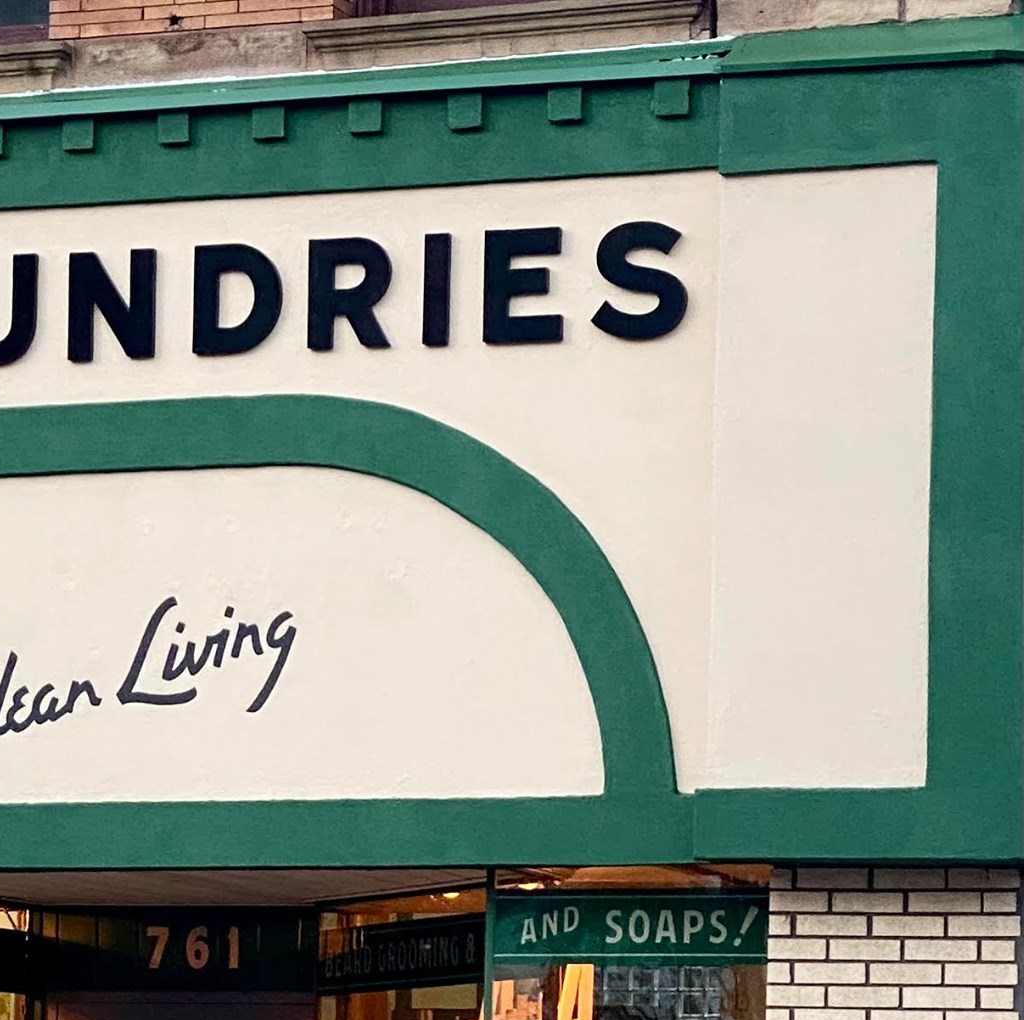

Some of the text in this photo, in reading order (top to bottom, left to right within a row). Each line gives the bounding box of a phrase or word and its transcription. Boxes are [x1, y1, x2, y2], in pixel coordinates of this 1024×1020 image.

[117, 596, 297, 712] Living
[146, 926, 240, 969] 761
[521, 905, 759, 947] AND SOAPS!
[325, 932, 477, 979] BEARD GROOMING &
